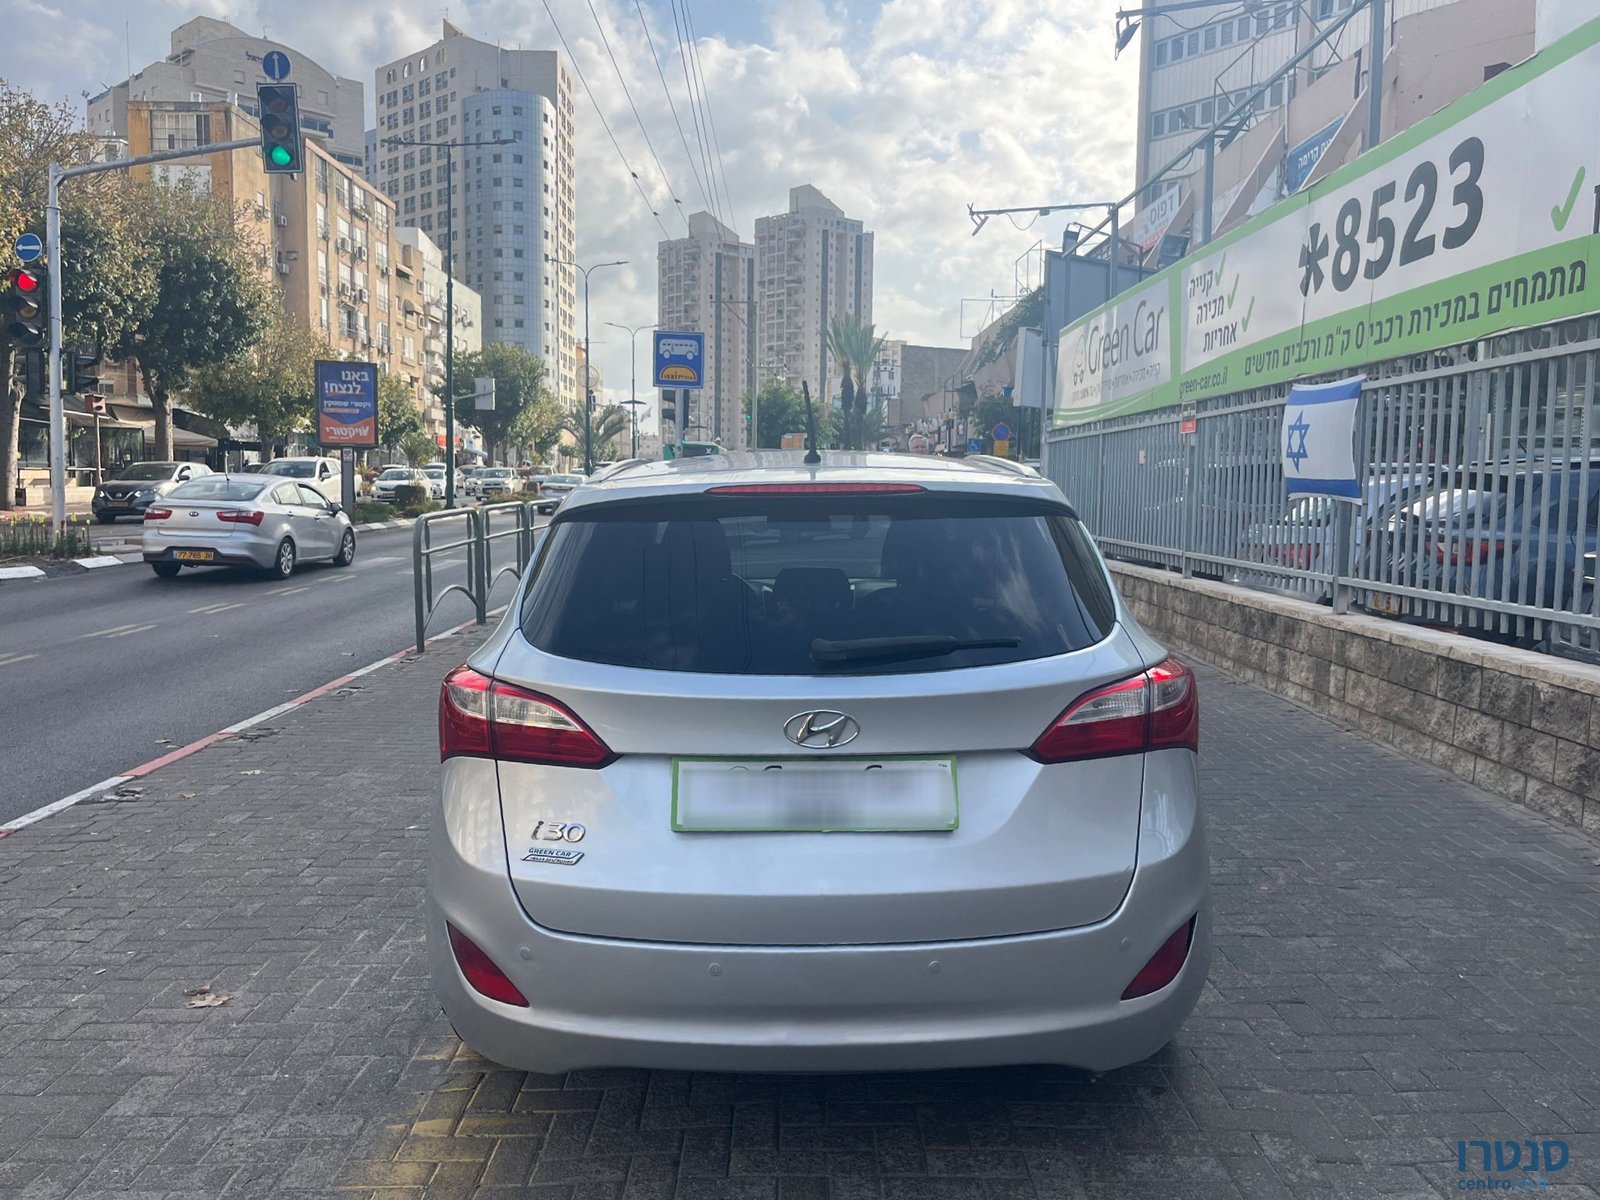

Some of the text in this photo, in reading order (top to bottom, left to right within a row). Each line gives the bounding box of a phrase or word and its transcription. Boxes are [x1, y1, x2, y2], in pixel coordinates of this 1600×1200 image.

[1298, 147, 1319, 170] קדימה
[1150, 194, 1174, 225] דפוס
[1189, 270, 1214, 299] קנייה
[1196, 295, 1225, 325] מכירה
[1244, 259, 1586, 376] מתמחים במכירת רכבי 0 ק"מ ורכבים חדשים
[1088, 299, 1164, 375] Green Car
[1203, 321, 1238, 353] אחריות
[324, 381, 361, 394] לנצח!
[341, 370, 370, 381] באנו
[1179, 365, 1228, 399] green-car.co.il
[531, 820, 586, 843] i30
[528, 847, 555, 856] GREEN
